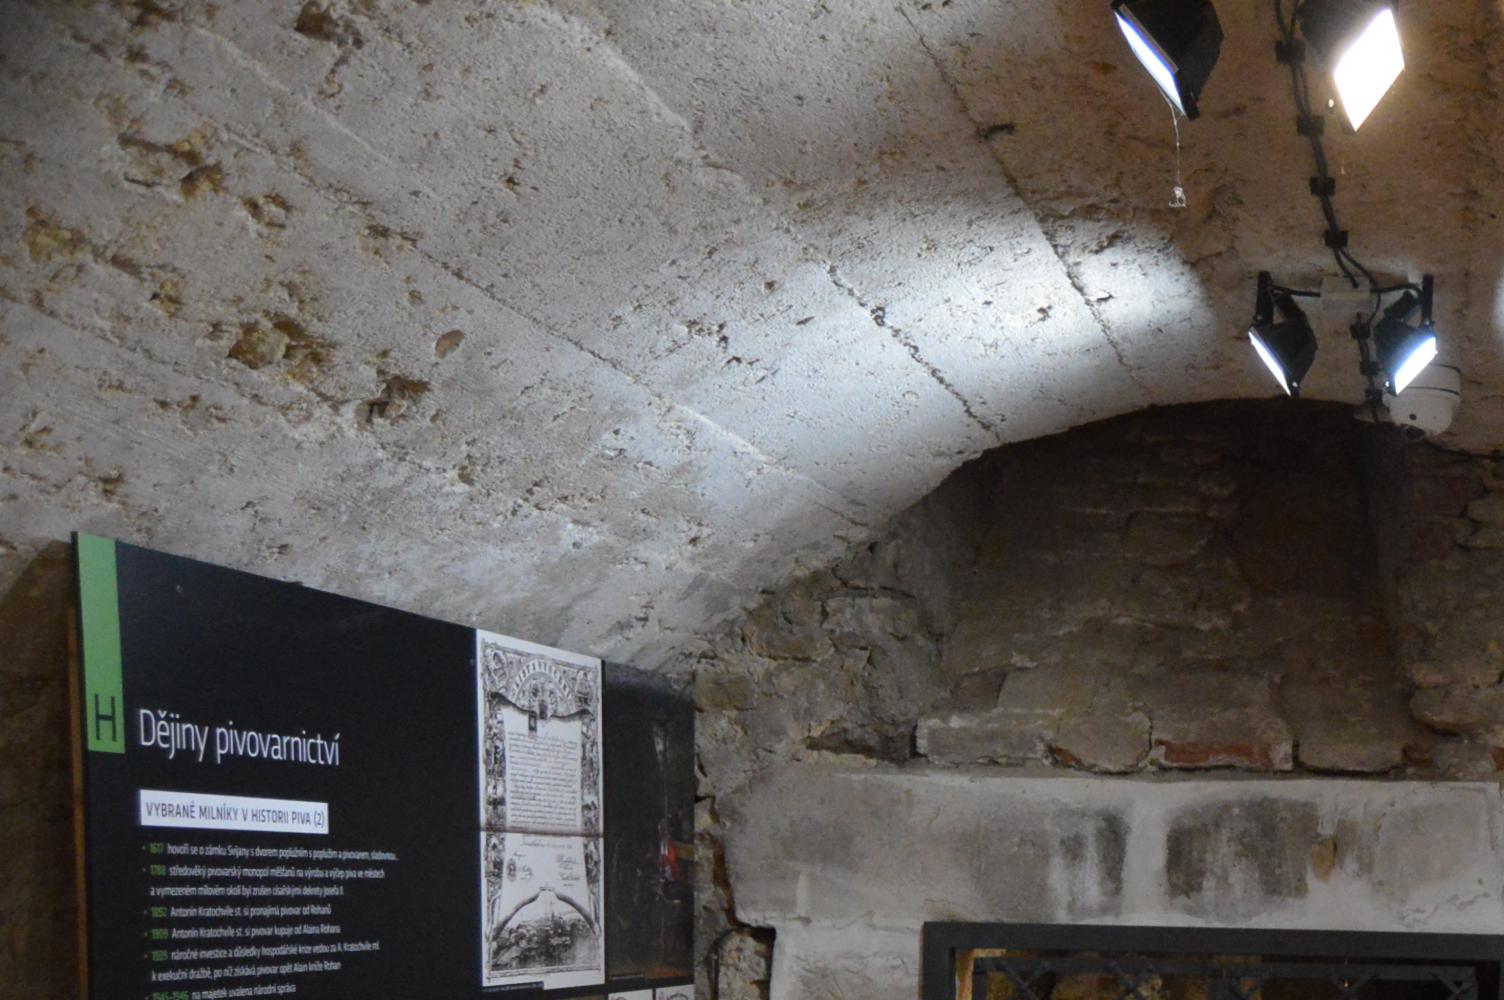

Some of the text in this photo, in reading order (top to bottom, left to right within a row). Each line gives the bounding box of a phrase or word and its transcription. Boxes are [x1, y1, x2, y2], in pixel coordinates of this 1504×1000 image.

[95, 693, 117, 743] H
[139, 708, 341, 766] Dějiny pivovarnictví
[145, 800, 326, 828] VYBRANÉ MILNÍKY V HISTORII PIVA (2)
[191, 846, 198, 855] se
[242, 866, 269, 880] monopol
[150, 887, 156, 896] a
[170, 905, 197, 917] Antonín
[302, 904, 310, 916] od
[172, 927, 199, 939] Antonín
[293, 924, 302, 935] od
[152, 969, 158, 982] k
[191, 991, 201, 1000] na
